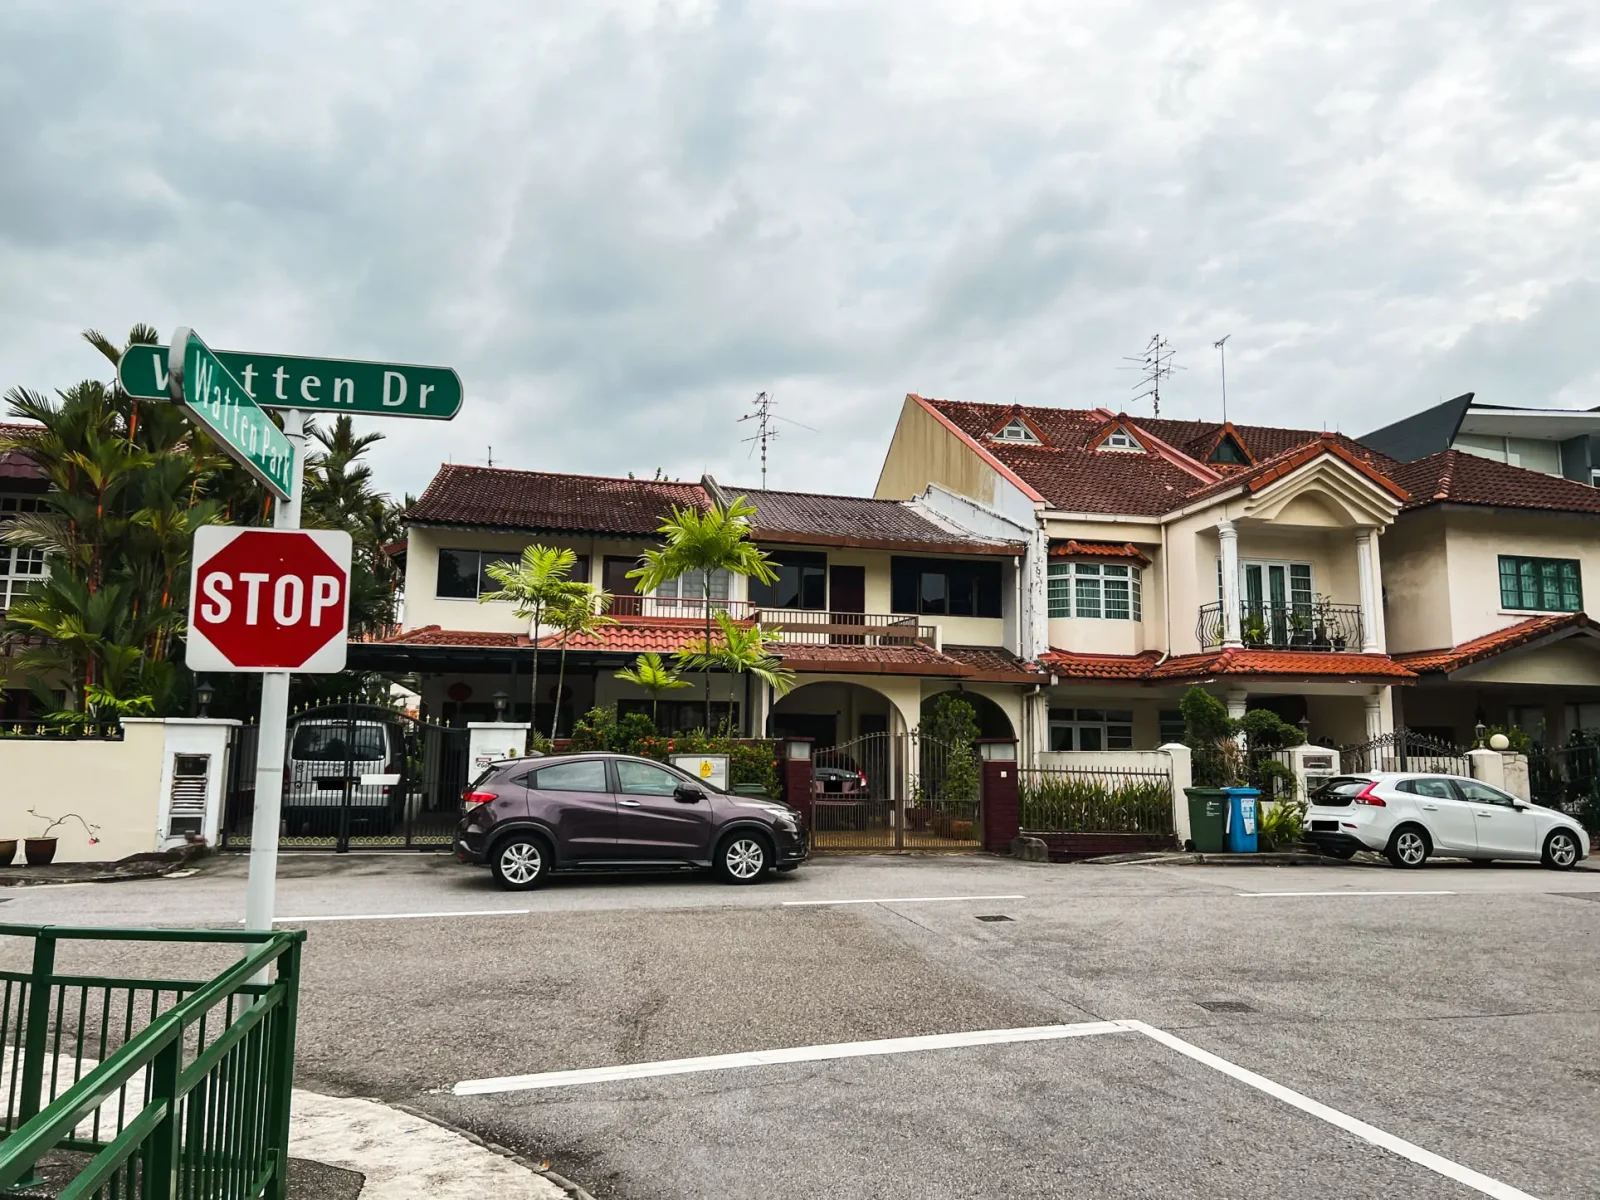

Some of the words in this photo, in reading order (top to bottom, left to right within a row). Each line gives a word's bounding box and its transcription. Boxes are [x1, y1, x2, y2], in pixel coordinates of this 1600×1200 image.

[153, 354, 354, 403] tten
[382, 371, 435, 409] Dr
[195, 350, 257, 455] Watten
[262, 425, 290, 487] Park
[201, 571, 340, 627] STOP
